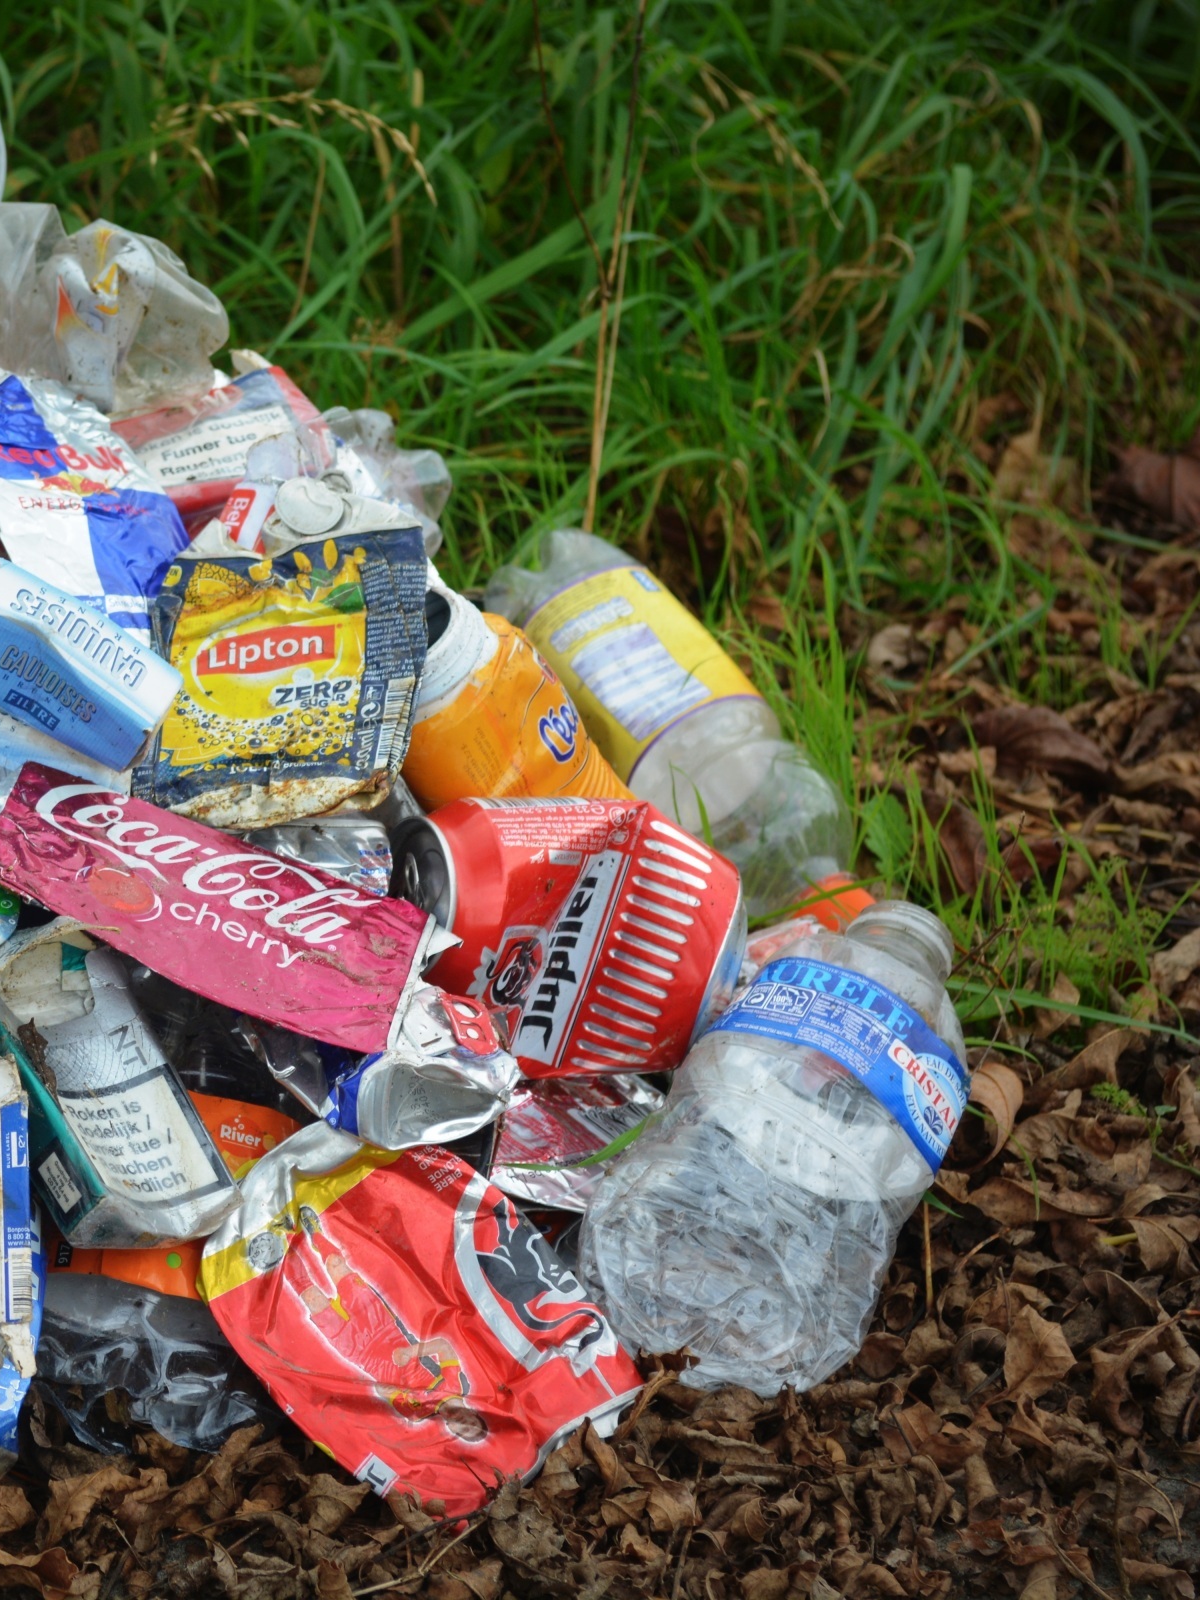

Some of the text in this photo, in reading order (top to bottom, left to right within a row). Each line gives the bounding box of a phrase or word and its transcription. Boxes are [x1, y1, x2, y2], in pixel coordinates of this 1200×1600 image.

[54, 443, 129, 474] Bull
[161, 432, 258, 462] Fumer tue
[10, 588, 148, 692] GAULOISES
[207, 635, 324, 670] Lipton
[275, 680, 352, 707] ZERO
[300, 693, 347, 708] SUGR
[6, 693, 59, 728] FILTRE
[137, 769, 154, 777] BRAN
[35, 783, 386, 946] Coca-Cola
[169, 901, 304, 969] cherry
[520, 876, 599, 1052] Jupiler
[925, 1055, 947, 1073] EAU
[946, 1066, 959, 1086] DE
[65, 1100, 142, 1121] Roken is
[906, 1093, 926, 1120] ETAT
[10, 1131, 28, 1168] L&
[128, 1137, 161, 1155] tue
[219, 1124, 262, 1148] River
[411, 1144, 435, 1162] BIER
[427, 1154, 463, 1184] BLONDE
[434, 1168, 463, 1193] BIERE
